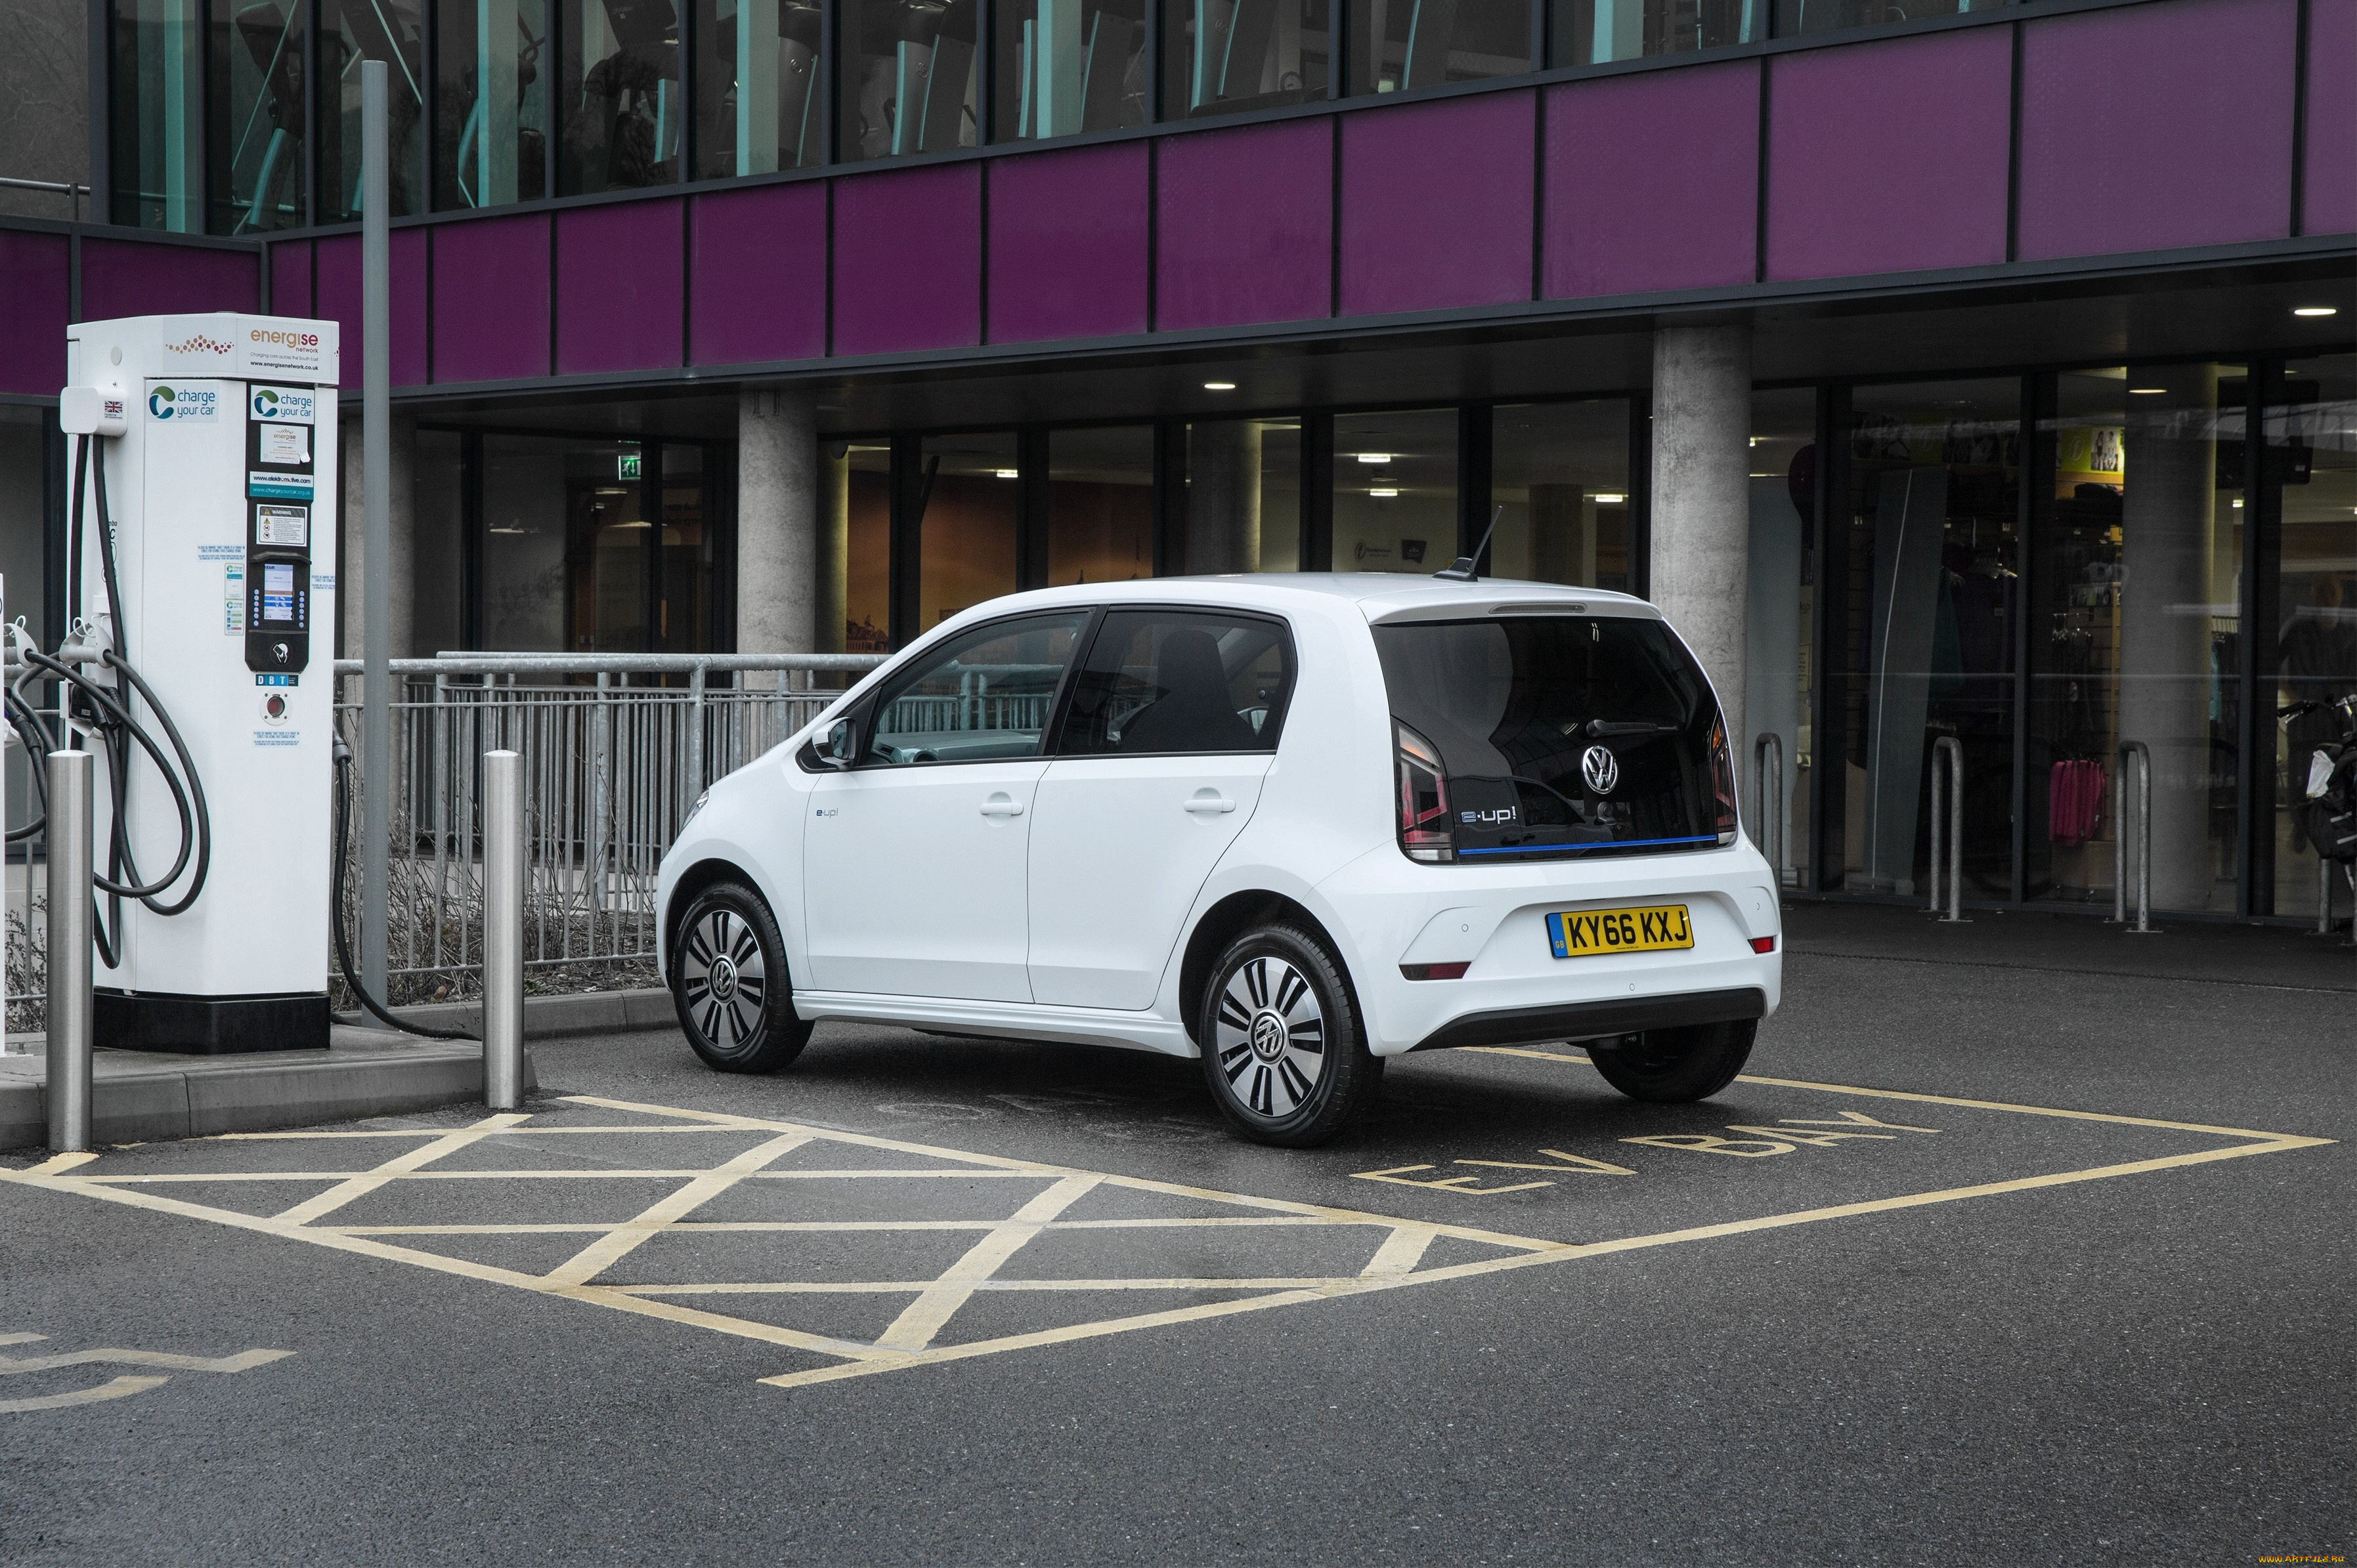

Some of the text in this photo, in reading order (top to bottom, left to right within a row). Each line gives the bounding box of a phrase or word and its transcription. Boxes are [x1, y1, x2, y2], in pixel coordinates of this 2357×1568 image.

[250, 329, 318, 348] energise
[250, 361, 318, 370] www.energisenetwork.co.uk
[178, 389, 215, 406] charge
[280, 394, 312, 409] charge
[177, 407, 198, 418] your
[280, 408, 298, 417] your
[253, 487, 311, 496] www.chargeyourcar.org.uk
[258, 676, 285, 685] DBT
[1568, 911, 1687, 948] KY66 KXJ
[1555, 940, 1564, 949] GB
[1349, 1111, 1943, 1196] EV BAY
